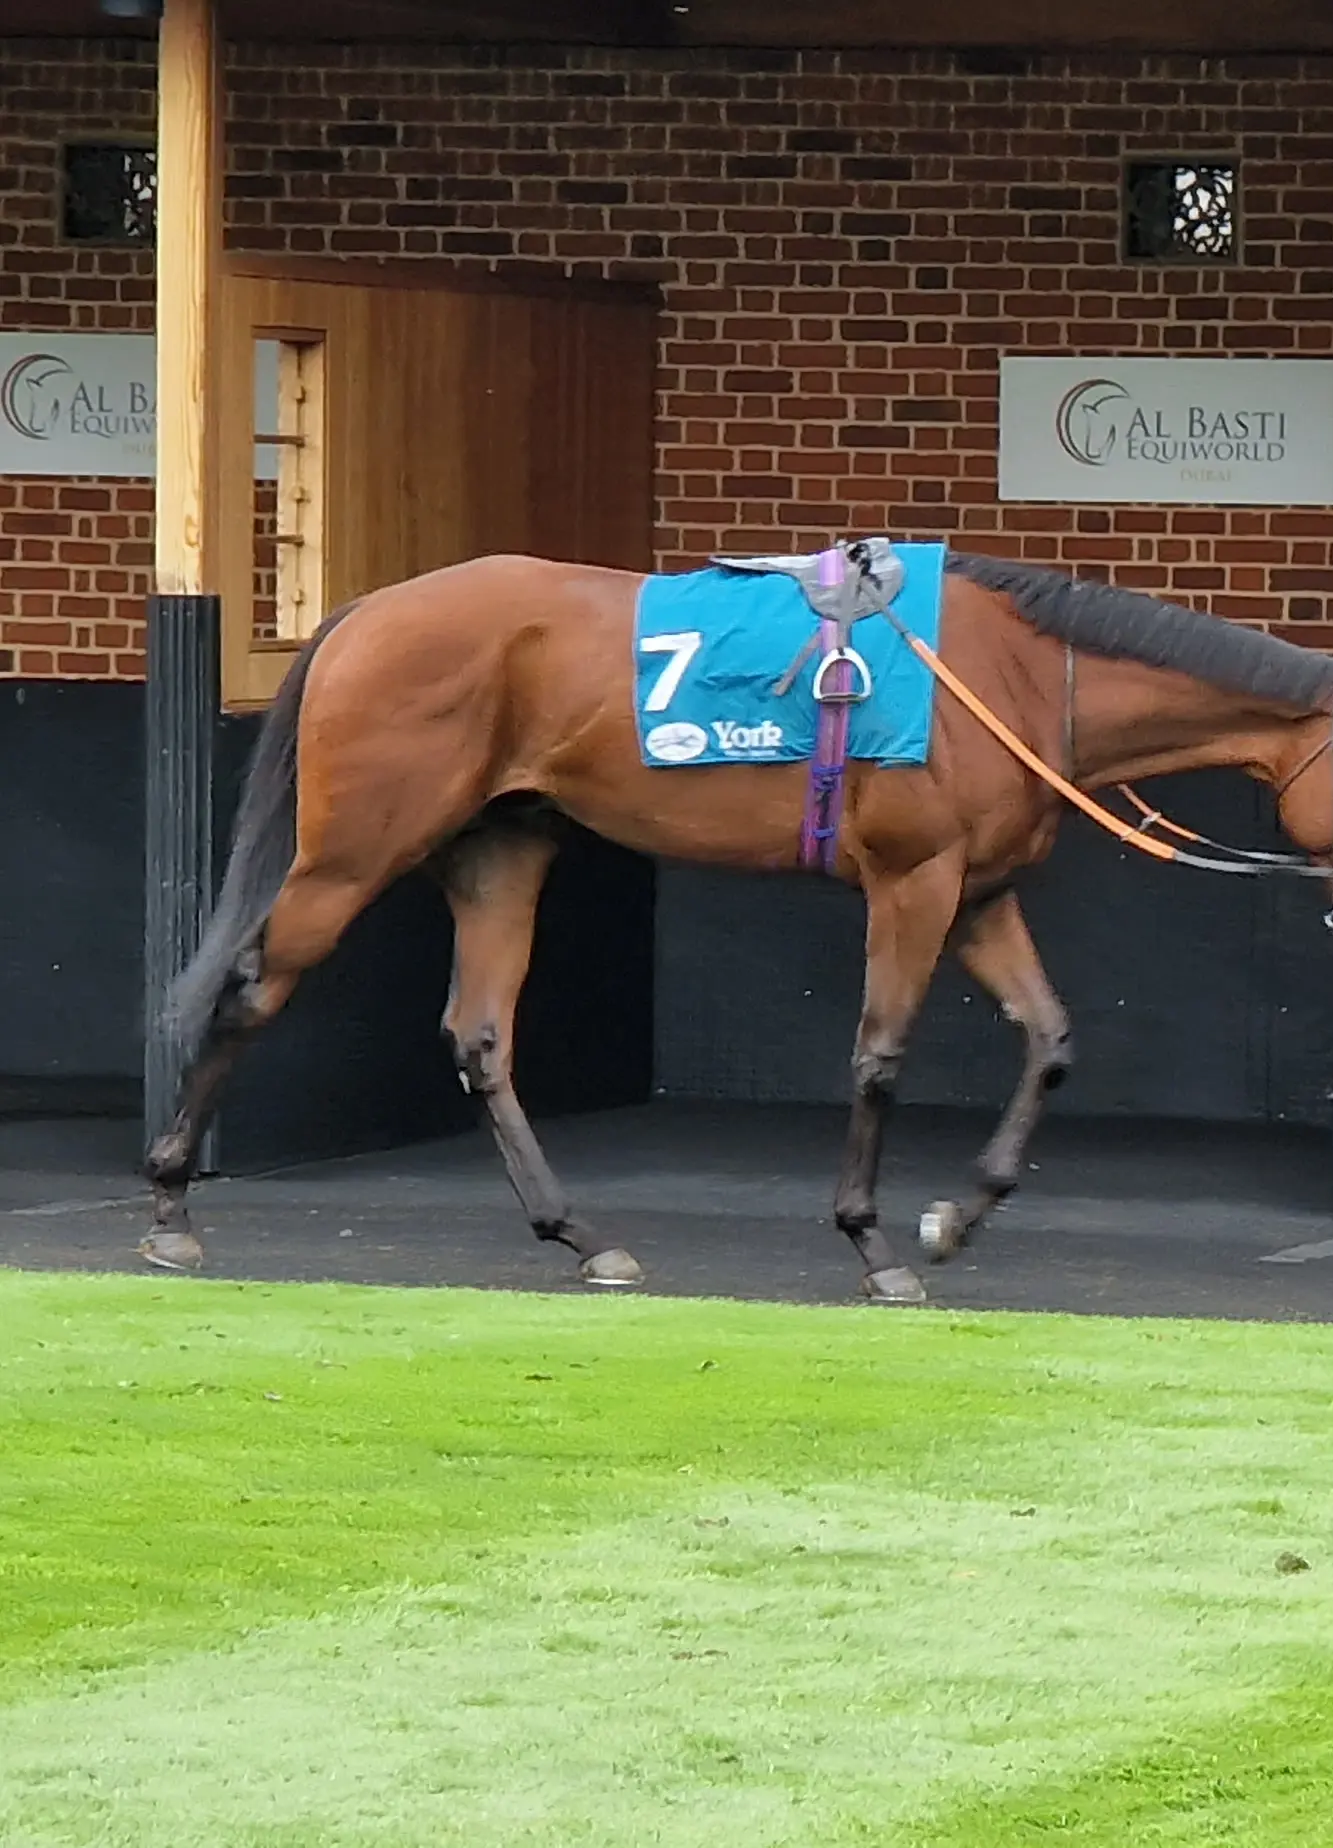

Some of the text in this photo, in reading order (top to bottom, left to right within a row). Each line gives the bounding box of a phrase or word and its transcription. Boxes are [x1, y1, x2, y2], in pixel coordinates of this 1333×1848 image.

[70, 381, 113, 413] AL
[1125, 406, 1286, 441] AL BASTI
[1126, 439, 1286, 464] EQUIWORLD
[639, 631, 702, 712] 7
[710, 720, 784, 749] York
